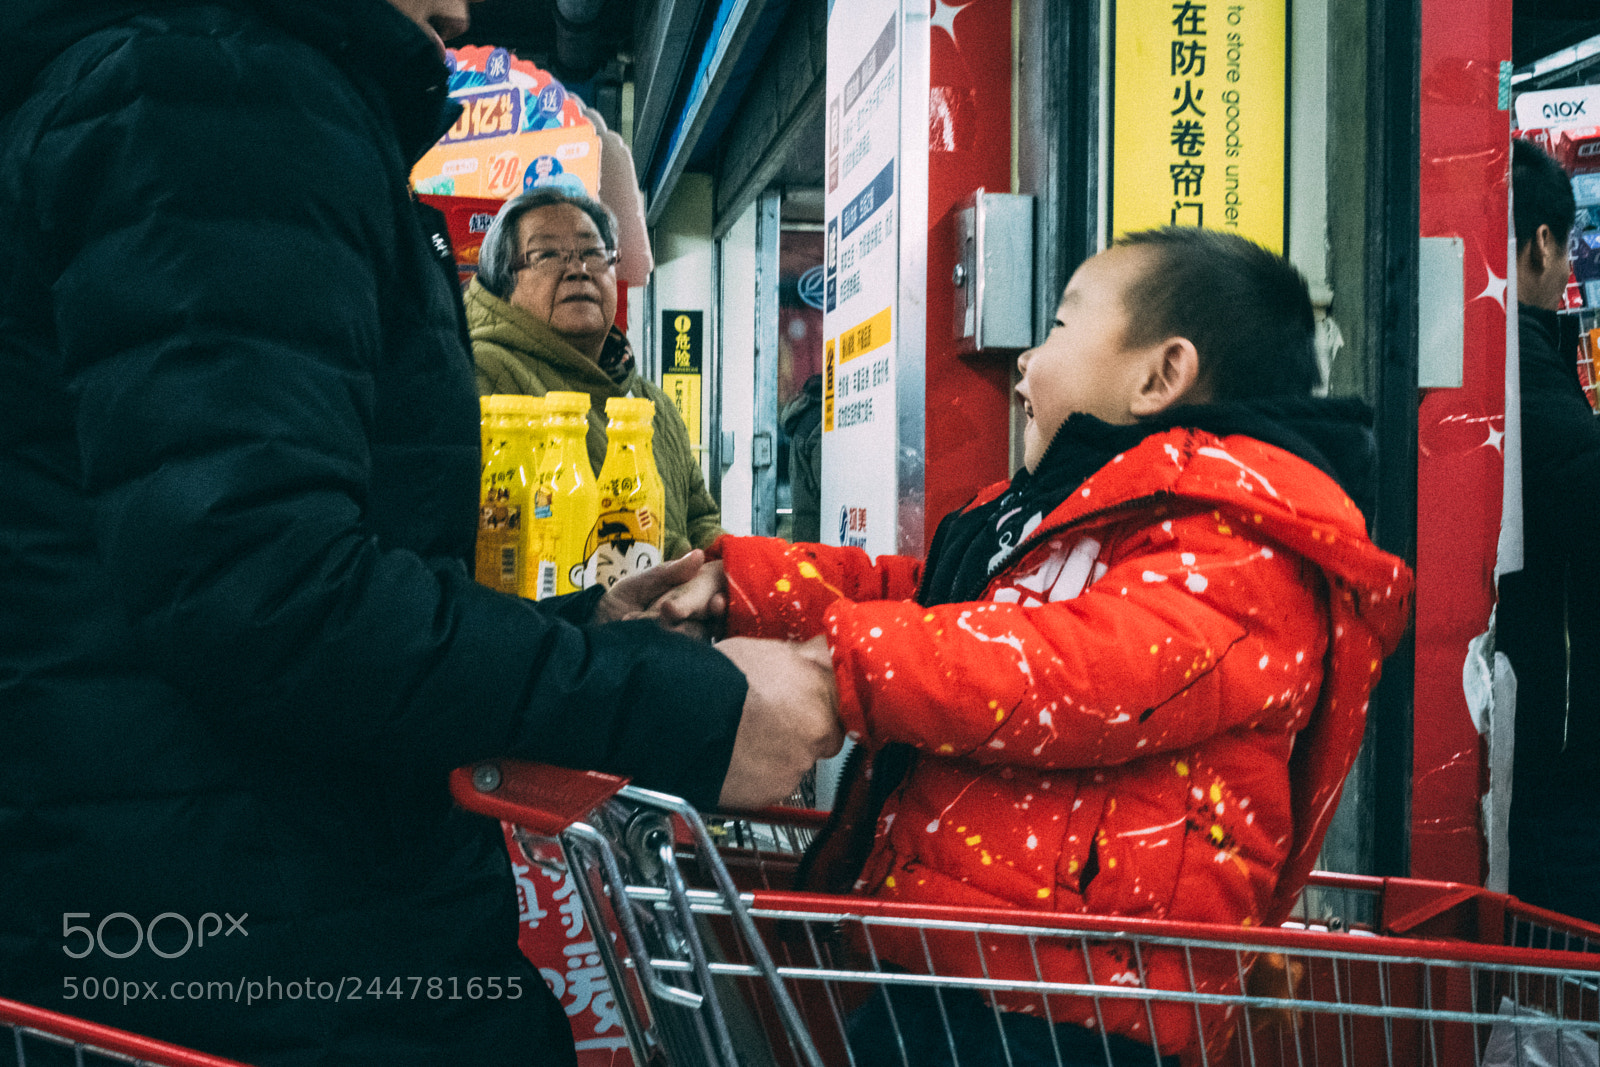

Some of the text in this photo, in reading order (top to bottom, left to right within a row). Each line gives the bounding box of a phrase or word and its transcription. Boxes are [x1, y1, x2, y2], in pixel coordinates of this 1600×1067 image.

[1170, 1, 1207, 227] 在防火卷帘门
[1222, 5, 1245, 227] to store goods under
